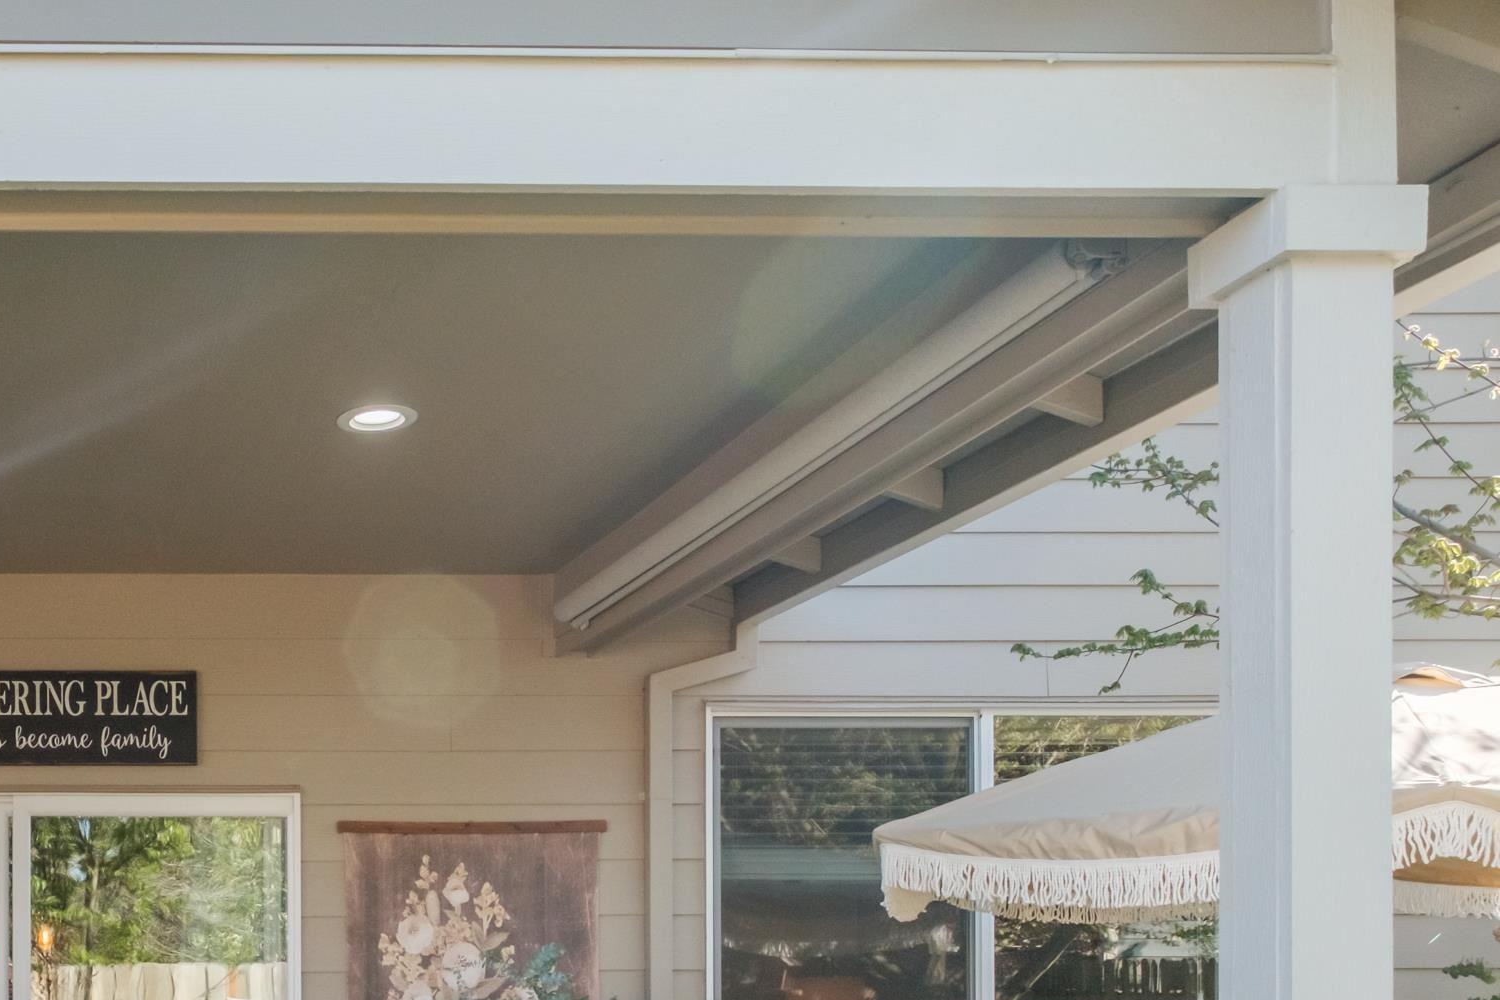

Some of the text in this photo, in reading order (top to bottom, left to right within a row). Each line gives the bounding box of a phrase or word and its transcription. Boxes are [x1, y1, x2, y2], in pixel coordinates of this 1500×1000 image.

[94, 680, 188, 716] PLACE
[15, 726, 92, 749] become
[101, 725, 171, 759] family
